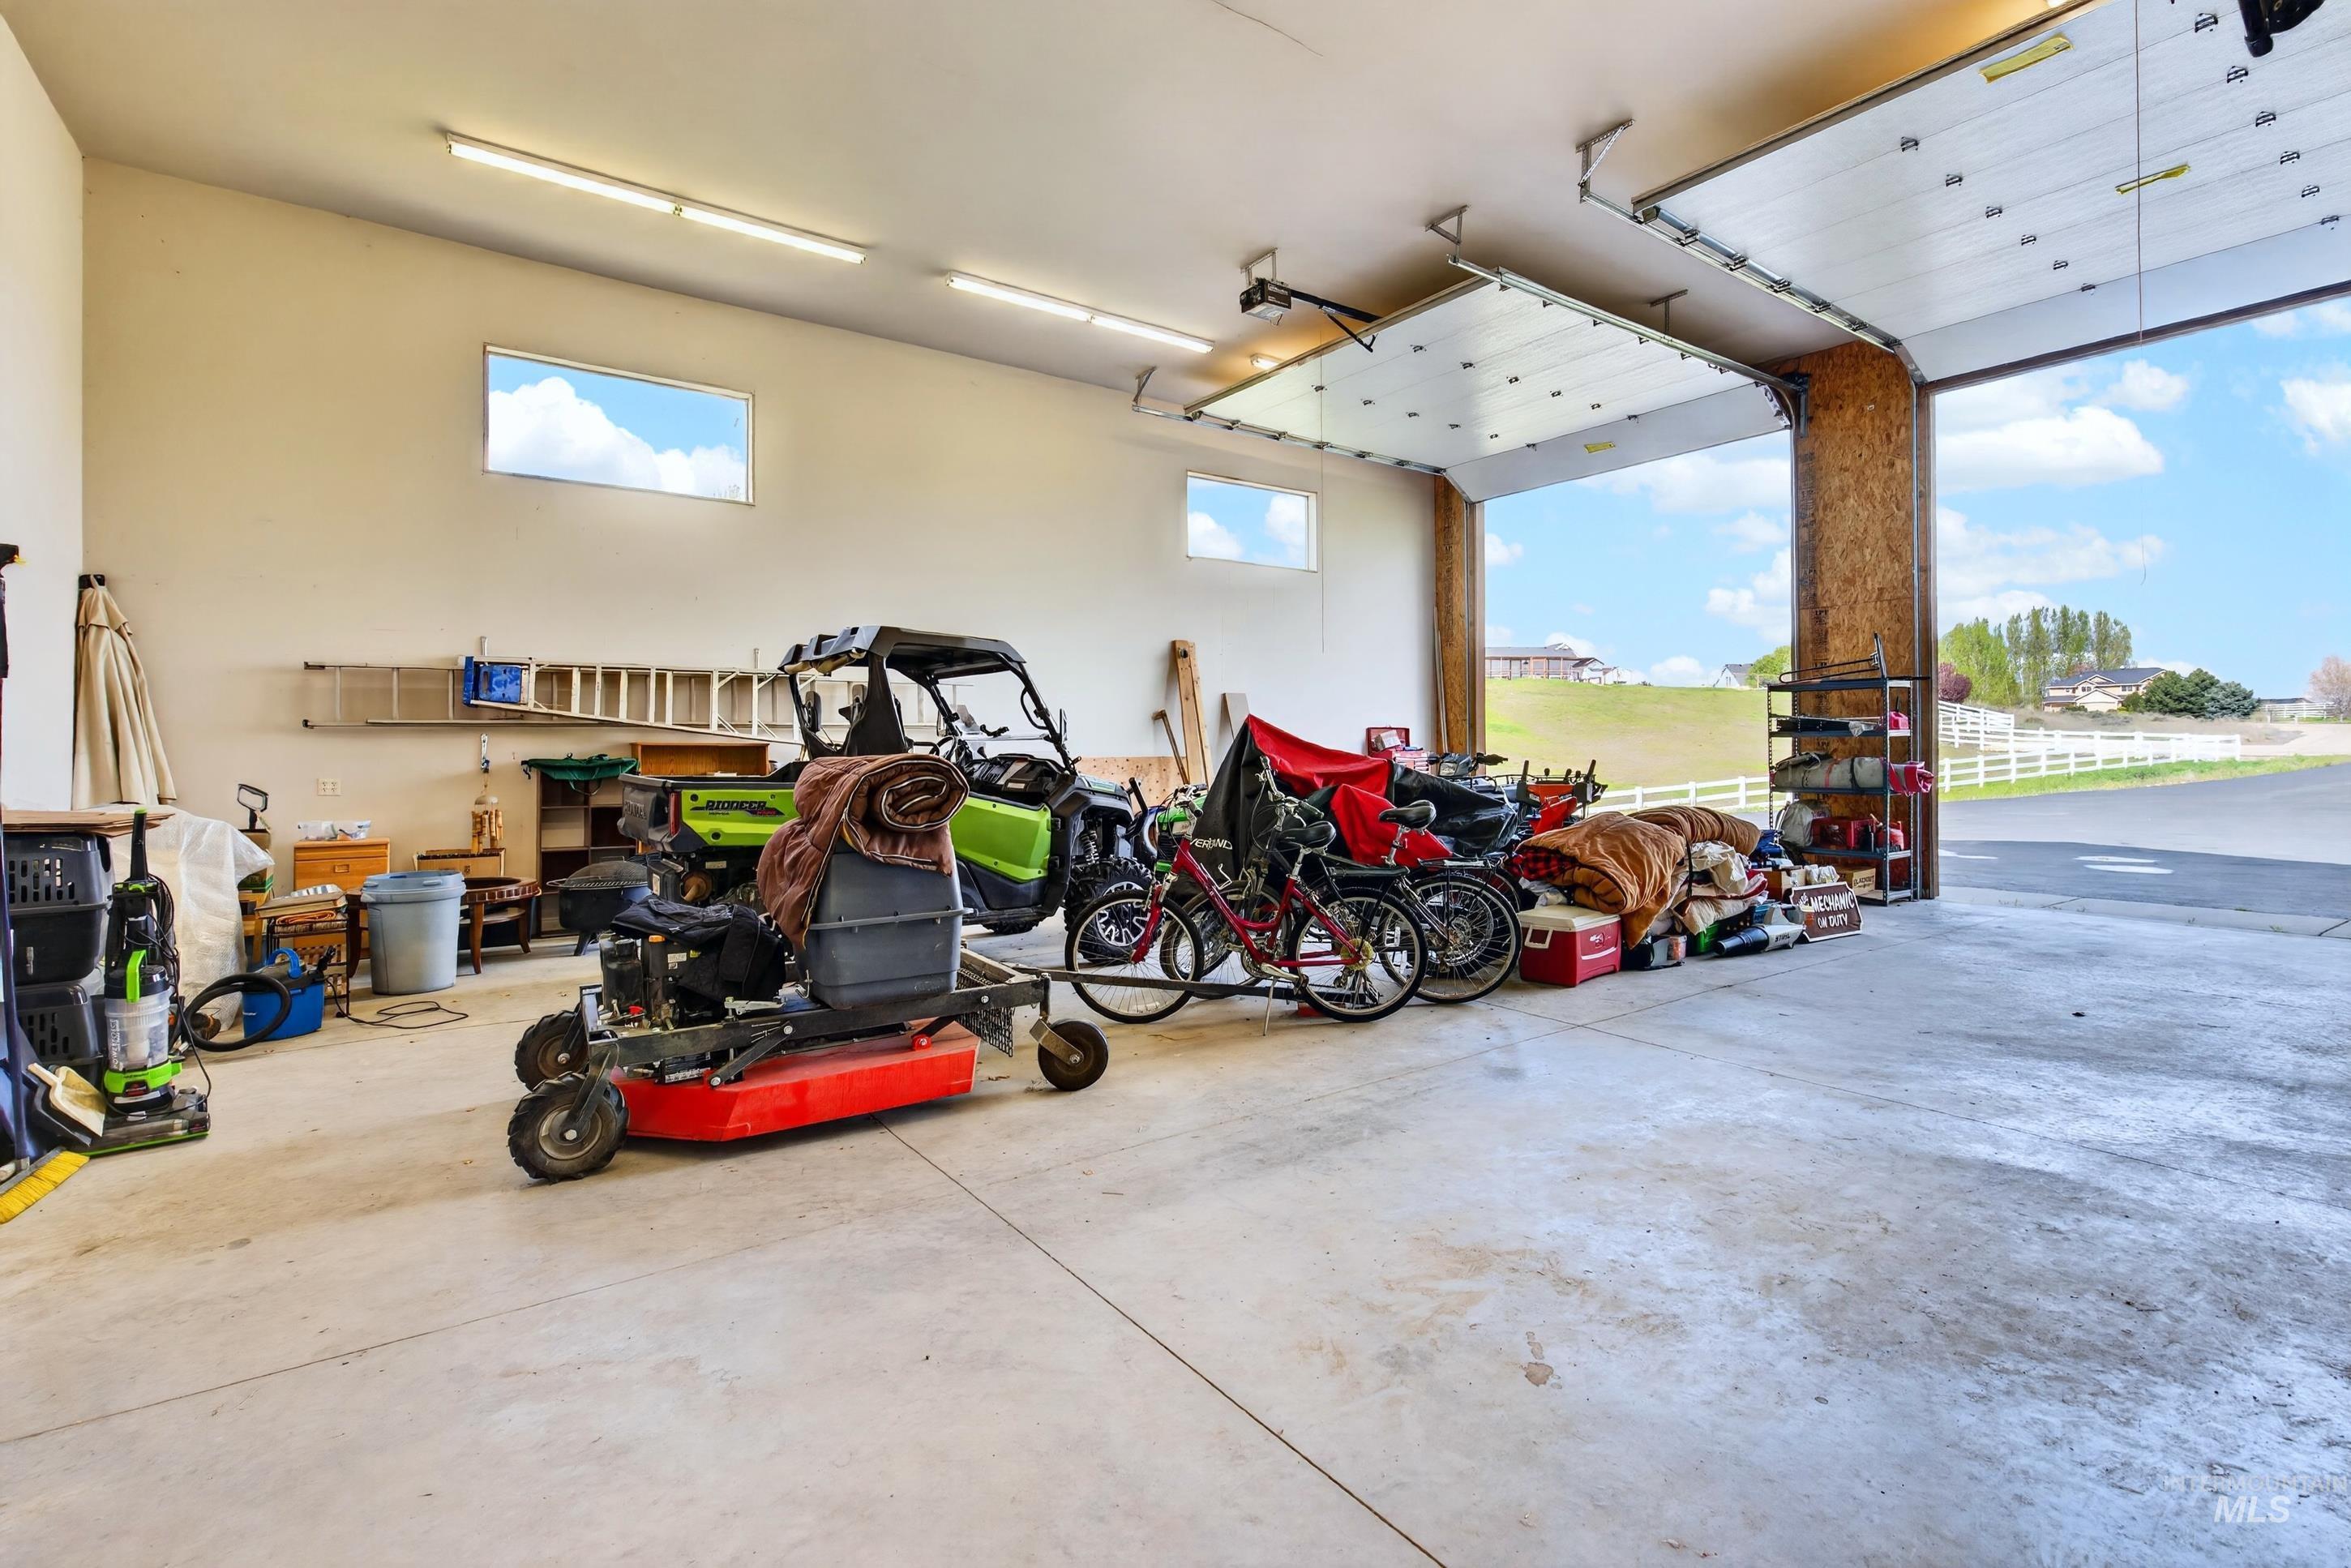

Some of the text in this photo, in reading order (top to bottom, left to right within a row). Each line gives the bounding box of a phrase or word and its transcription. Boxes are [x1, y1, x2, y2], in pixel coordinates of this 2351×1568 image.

[706, 800, 767, 811] PIONEER
[1810, 892, 1855, 913] MECHANIC
[1818, 914, 1848, 928] ON DUTY
